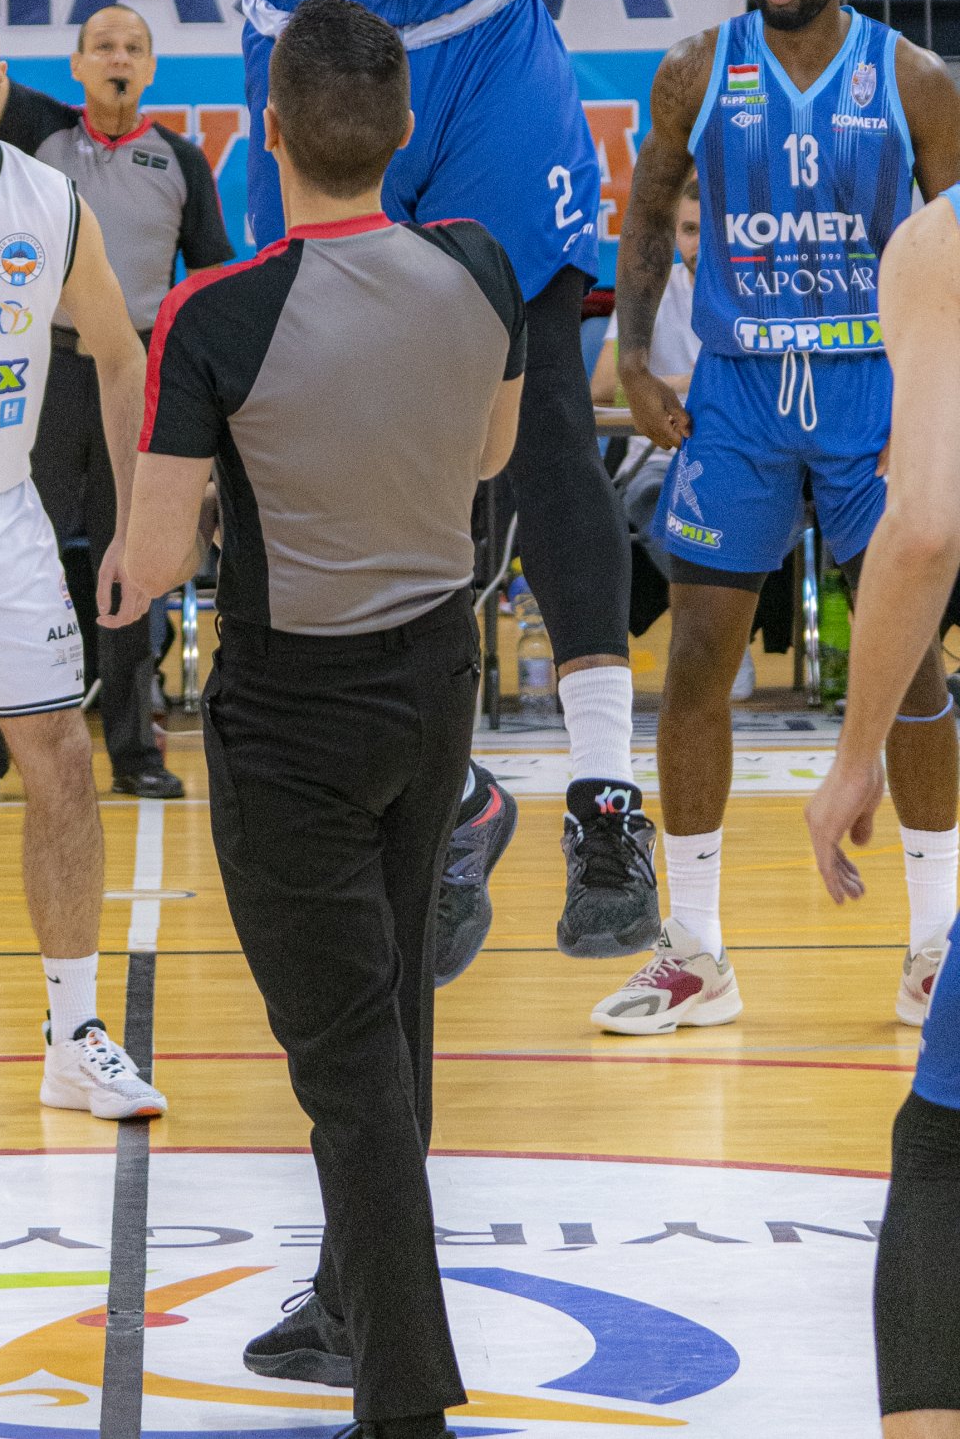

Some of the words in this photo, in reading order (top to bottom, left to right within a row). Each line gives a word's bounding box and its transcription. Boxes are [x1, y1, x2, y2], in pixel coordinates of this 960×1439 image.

[832, 113, 888, 129] KOMETA
[783, 133, 819, 188] 13
[547, 165, 583, 229] 2
[726, 211, 869, 249] KOMETA
[776, 253, 809, 262] ANNO
[815, 252, 841, 261] 1999
[735, 263, 877, 296] KAPOSVÁR
